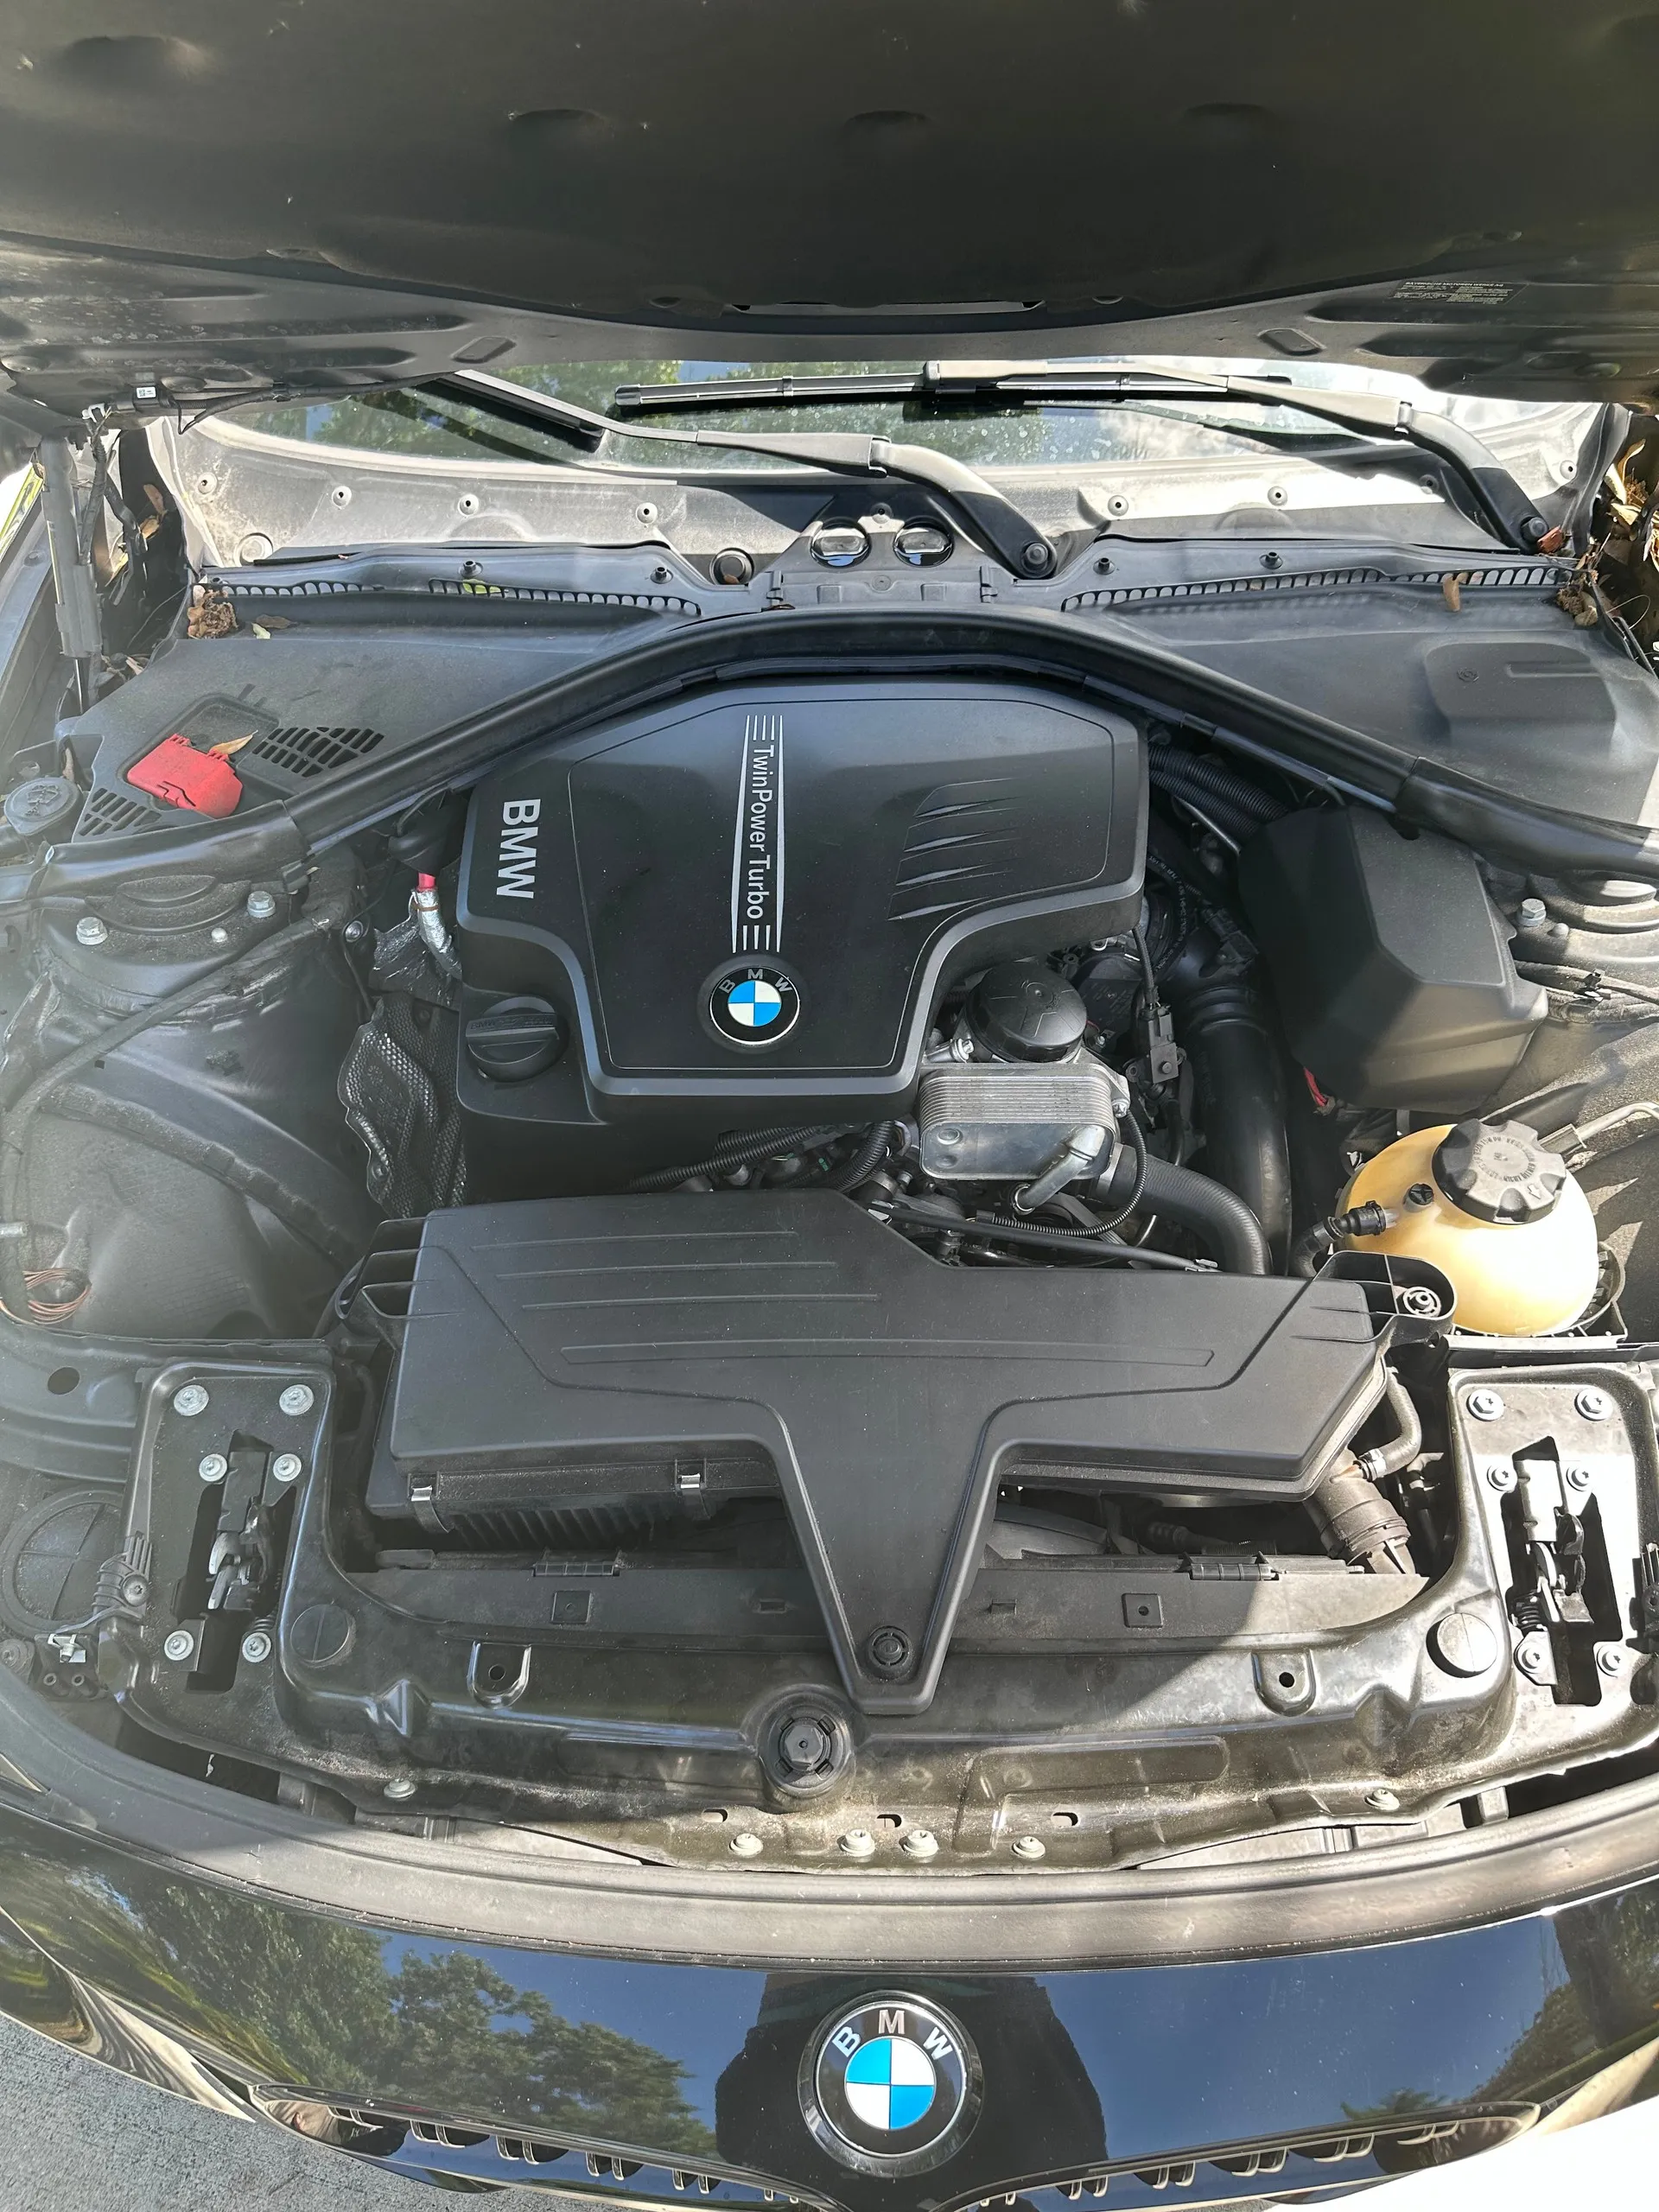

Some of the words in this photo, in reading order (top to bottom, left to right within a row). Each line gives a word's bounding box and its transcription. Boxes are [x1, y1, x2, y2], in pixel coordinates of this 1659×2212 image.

[748, 745, 775, 853] TwinPower
[496, 798, 541, 899] BMW
[746, 855, 771, 919] Turbo
[718, 969, 793, 994] BMW
[831, 2009, 954, 2061] BMW
